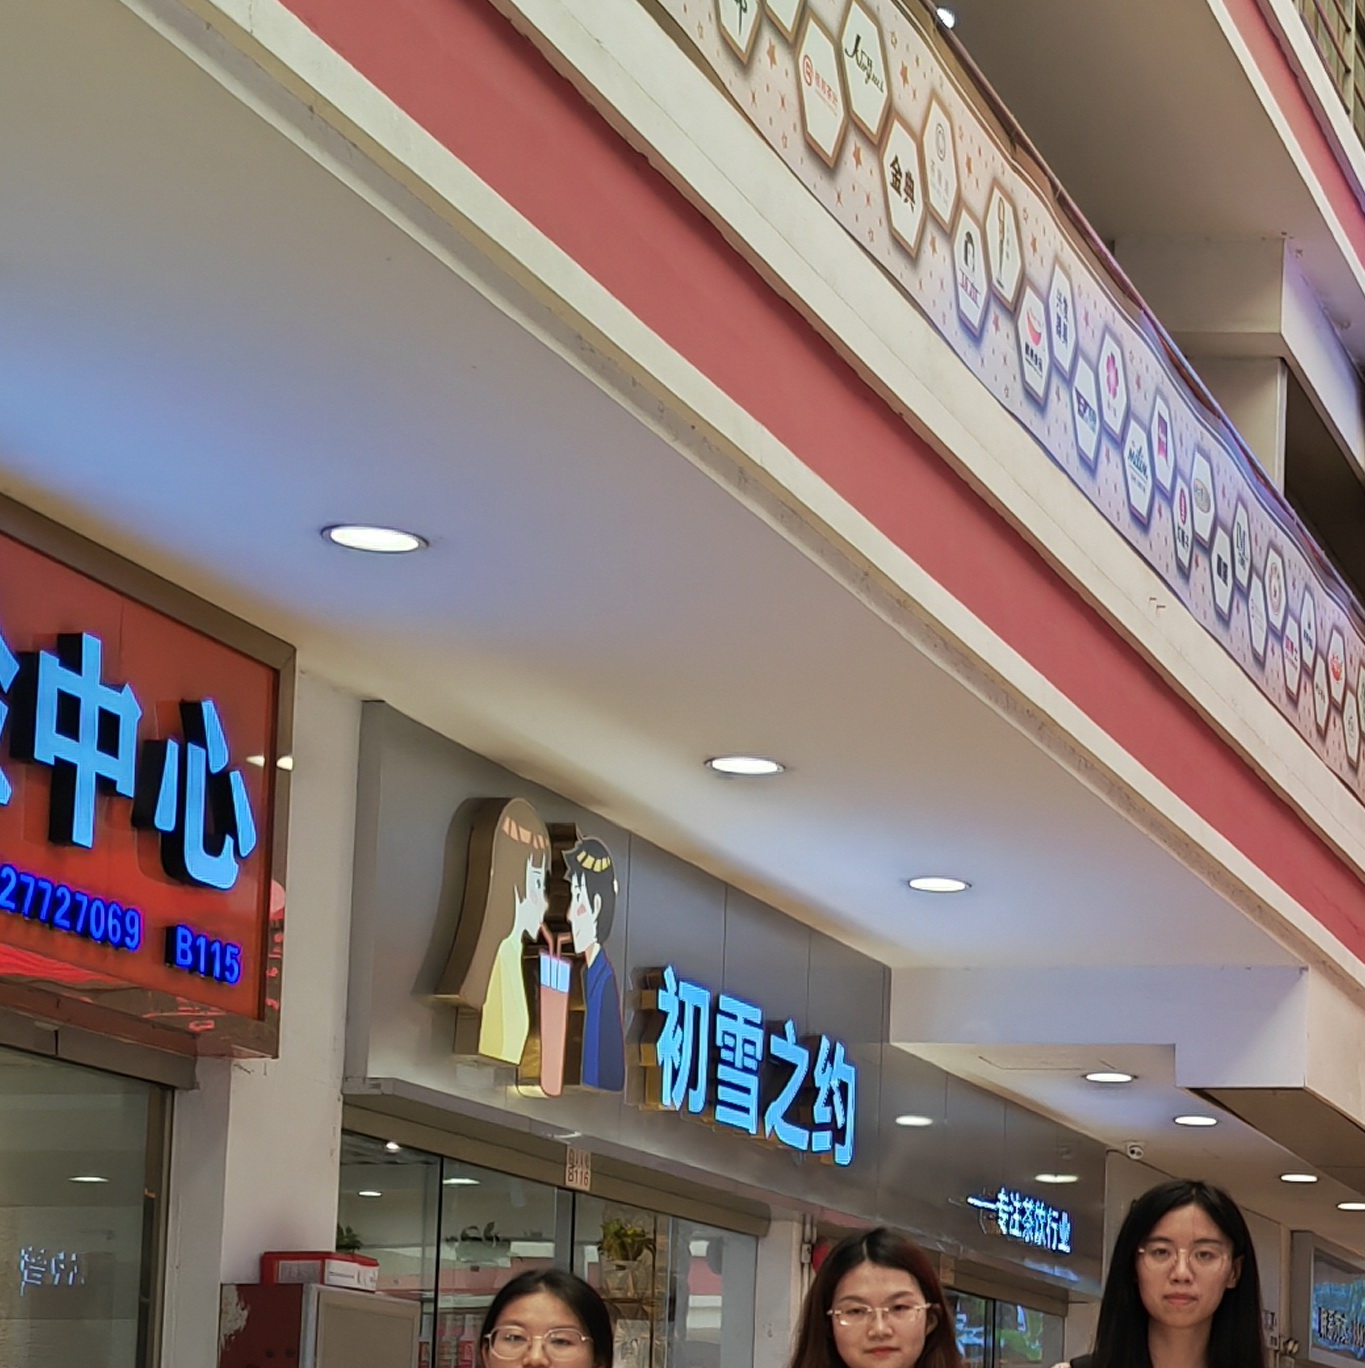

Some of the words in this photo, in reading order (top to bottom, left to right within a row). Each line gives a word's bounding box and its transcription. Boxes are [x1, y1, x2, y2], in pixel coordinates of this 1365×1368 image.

[0, 631, 258, 890] 中心
[0, 864, 141, 951] 27727069
[175, 923, 241, 985] B115
[656, 963, 857, 1167] 初雪之约
